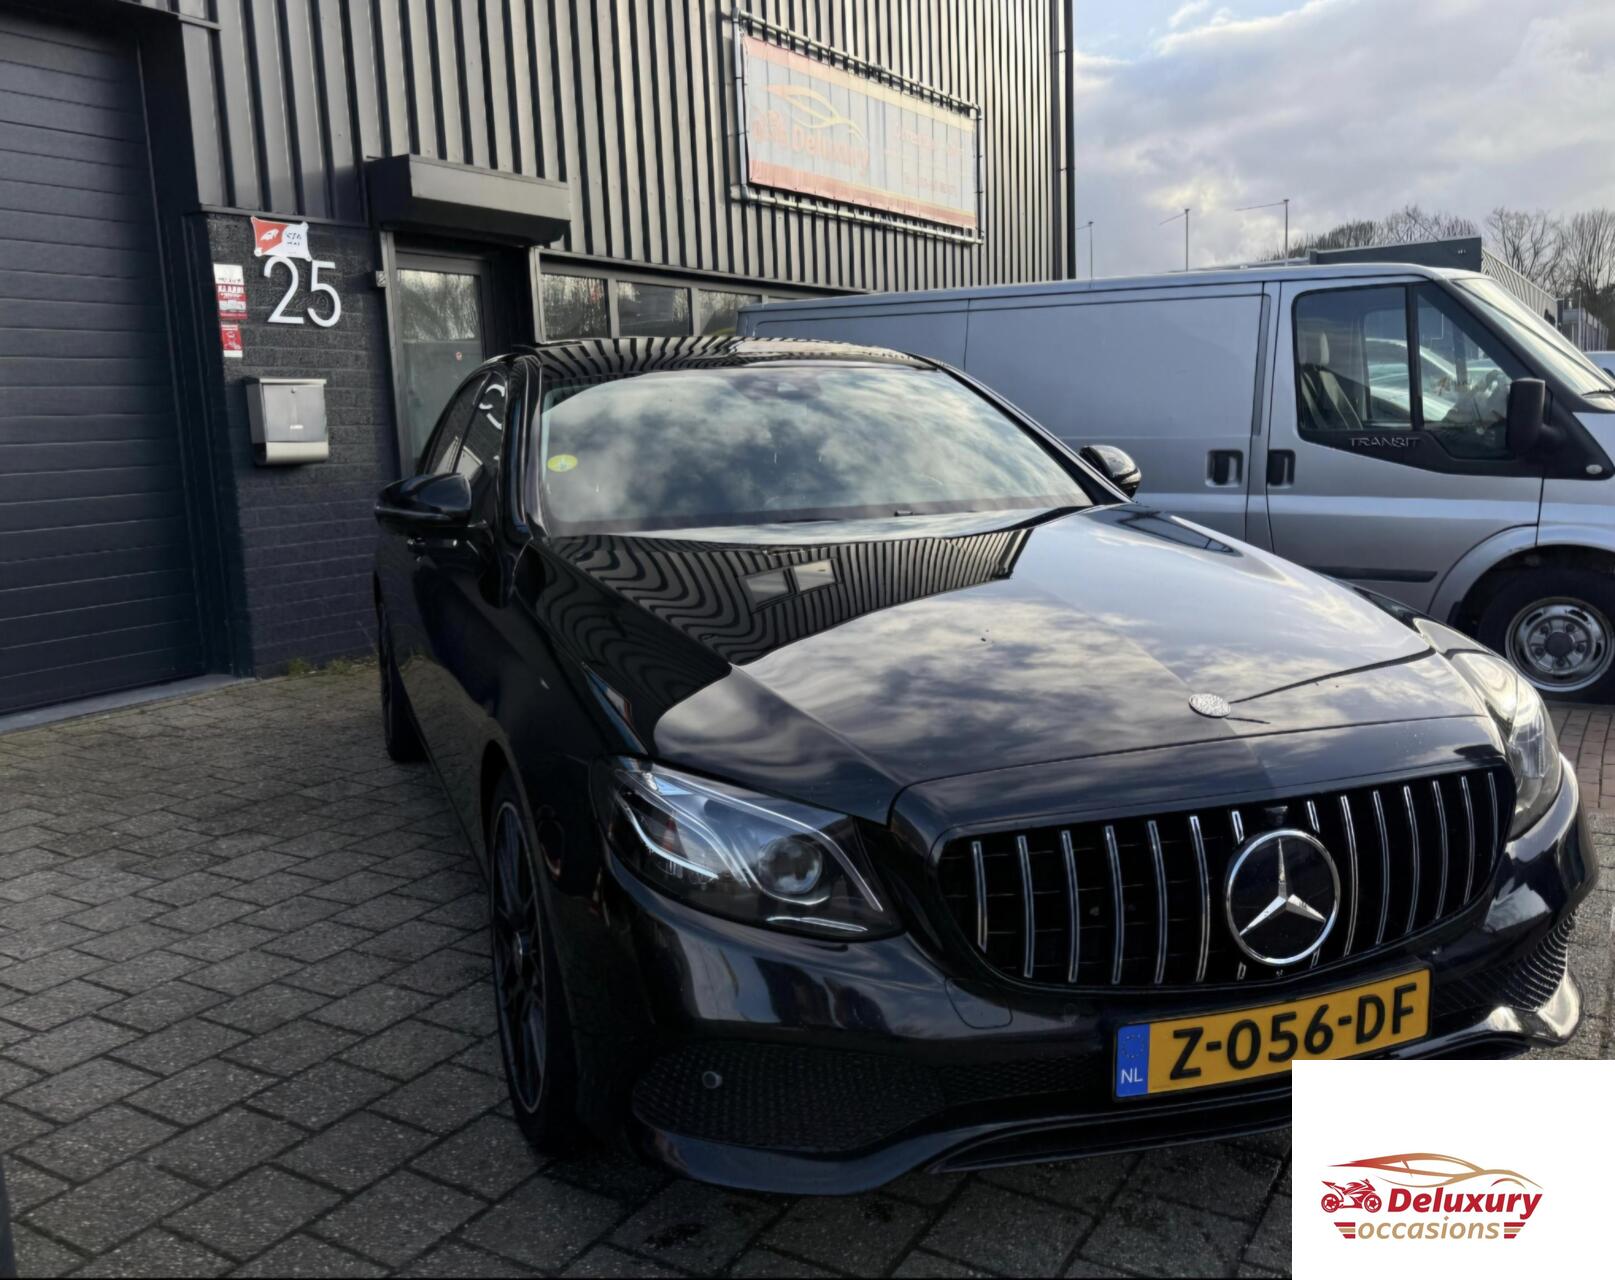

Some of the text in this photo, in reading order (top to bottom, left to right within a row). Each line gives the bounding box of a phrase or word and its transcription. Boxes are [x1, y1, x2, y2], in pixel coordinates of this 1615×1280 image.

[264, 255, 342, 328] 25
[1350, 436, 1420, 448] TRANSIT
[1169, 982, 1417, 1081] Z-056-DF
[1120, 1067, 1144, 1085] NL
